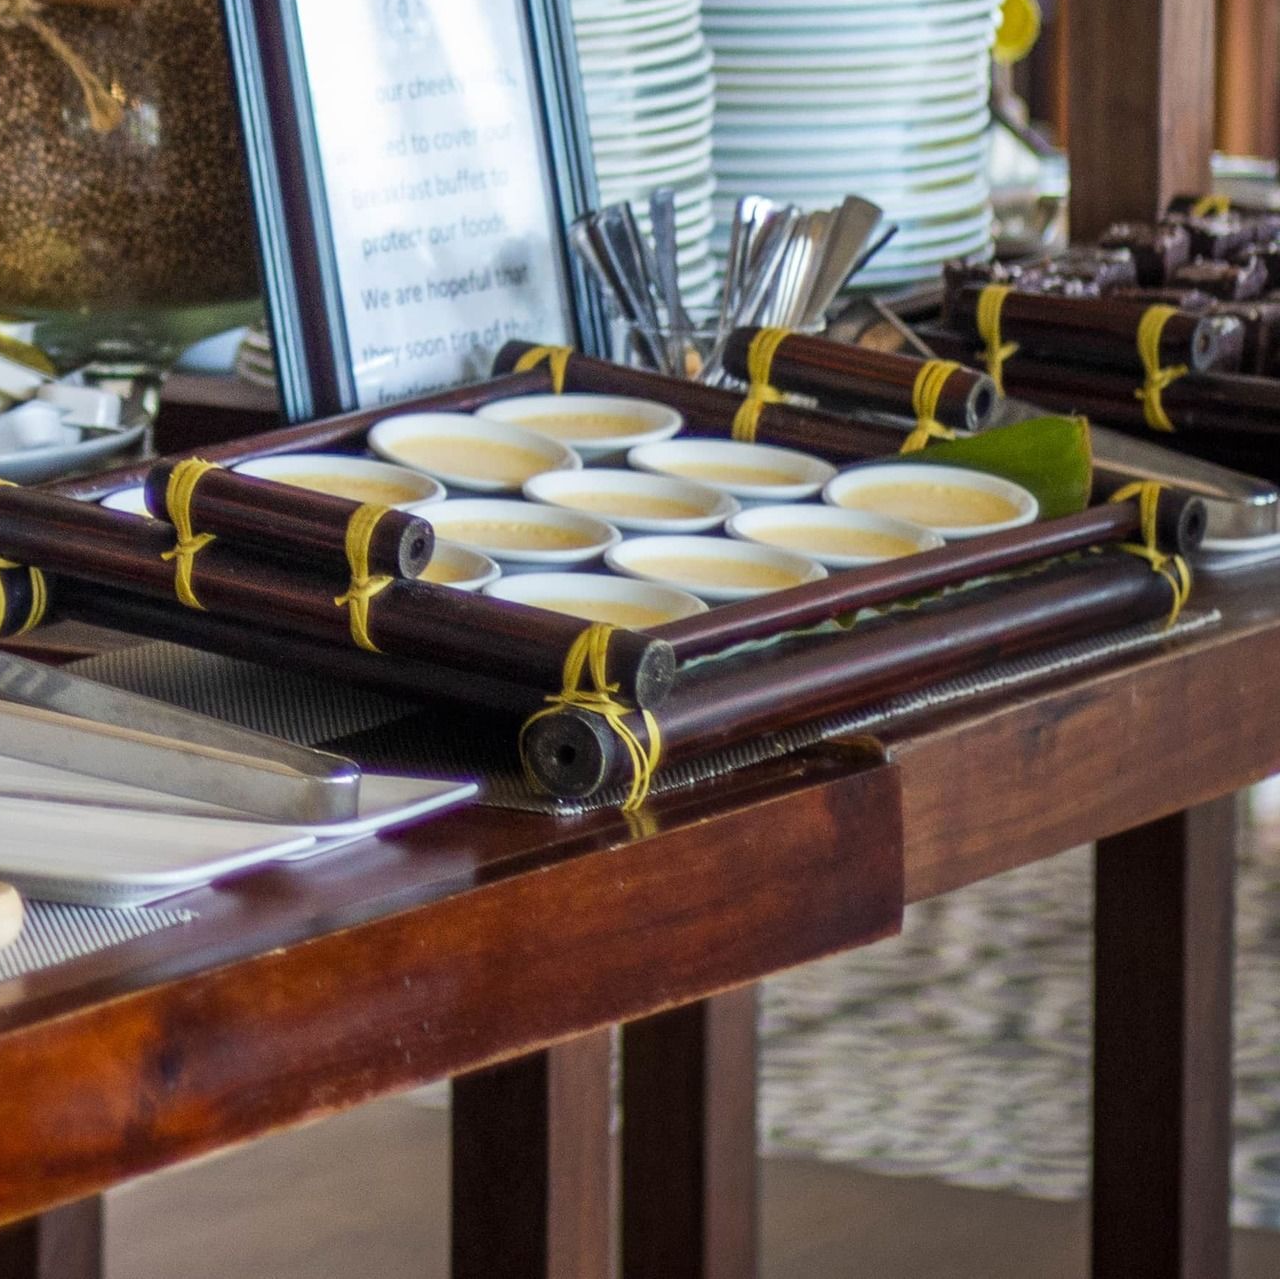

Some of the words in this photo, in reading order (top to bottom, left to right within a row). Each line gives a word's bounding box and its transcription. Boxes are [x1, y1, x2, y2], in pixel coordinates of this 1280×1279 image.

[433, 128, 478, 151] cover
[362, 226, 423, 260] protect
[429, 222, 457, 245] our
[361, 287, 390, 311] We
[395, 285, 423, 306] are
[426, 269, 492, 303] hopeful
[406, 336, 447, 360] soon
[450, 329, 480, 352] tire
[483, 320, 501, 346] of
